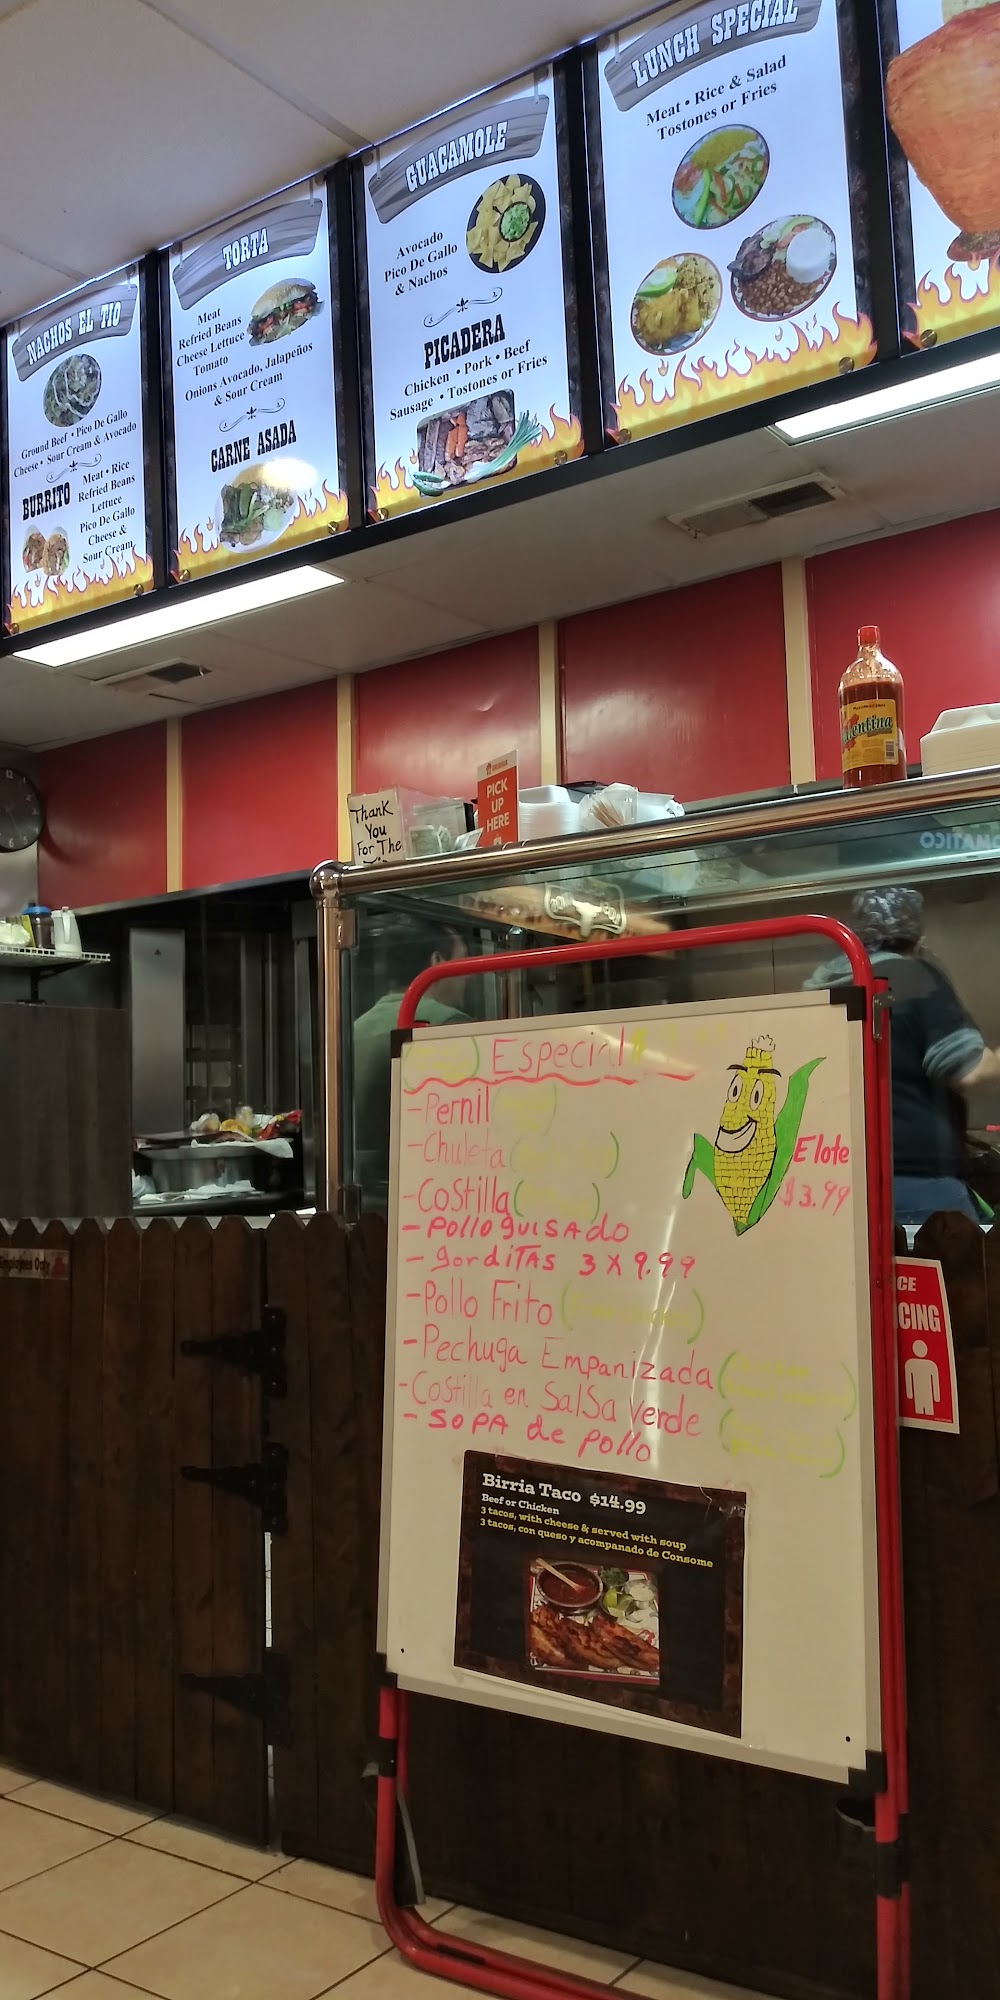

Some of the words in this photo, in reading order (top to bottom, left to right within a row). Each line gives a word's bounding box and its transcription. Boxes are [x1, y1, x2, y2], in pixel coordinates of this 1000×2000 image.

[631, 23, 701, 89] LUNCH
[710, 0, 799, 46] SPECIAL
[646, 102, 681, 127] Meat
[694, 83, 725, 105] Rice
[729, 75, 742, 90] &
[746, 55, 787, 83] Salad
[657, 106, 718, 141] Tostones
[721, 99, 737, 114] or
[741, 82, 778, 107] Fries
[405, 121, 509, 192] GUACAMOLE
[222, 227, 269, 271] TORTA
[384, 265, 408, 283] Pico
[409, 257, 425, 273] De
[427, 242, 458, 264] Gallo
[396, 231, 444, 260] Avocado
[395, 283, 405, 296] &
[408, 266, 449, 291] Nachos
[26, 317, 73, 366] NACHOS
[78, 308, 94, 335] EL
[100, 301, 121, 329] TIO
[178, 326, 212, 350] Refried
[215, 316, 242, 336] Beans
[197, 308, 221, 325] Meat
[176, 347, 208, 368] Cheese
[210, 330, 245, 352] Lettuce
[423, 313, 506, 370] PICADERA
[185, 380, 218, 402] Onions
[219, 362, 263, 388] Avocado,
[265, 342, 313, 370] Jalapeños
[193, 354, 229, 377] Tomato
[404, 372, 450, 397] Chicken
[464, 355, 493, 375] Pork
[503, 339, 531, 360] Beef
[213, 394, 223, 407] &
[225, 386, 248, 403] Sour
[250, 371, 283, 392] Cream
[390, 397, 434, 421] Sausage
[447, 373, 498, 400] Tostones
[501, 367, 514, 380] or
[517, 355, 548, 375] Fries
[13, 461, 39, 478] Cheese
[47, 450, 64, 465] Sour
[66, 441, 92, 457] Cream
[93, 435, 101, 445] &
[103, 421, 137, 442] Avocado
[21, 440, 49, 460] Ground
[51, 432, 68, 449] Beef
[76, 424, 92, 438] Pico
[94, 419, 105, 430] De
[106, 410, 128, 425] Gallo
[211, 436, 250, 473] CARNE
[257, 419, 297, 456] ASADA
[78, 483, 108, 502] Refried
[110, 474, 136, 490] Beans
[82, 470, 104, 485] Meat
[111, 460, 130, 474] Rice
[22, 481, 70, 521] BURRITO
[80, 519, 97, 533] Pico
[99, 514, 110, 525] De
[112, 506, 136, 522] Gallo
[91, 495, 123, 513] Lettuce
[82, 550, 103, 563] Sour
[104, 539, 133, 557] Cream
[88, 530, 117, 546] Cheese
[118, 524, 127, 535] &
[486, 778, 509, 799] PICK
[491, 797, 504, 813] UP
[349, 800, 394, 824] Thank
[486, 812, 510, 833] HERE
[357, 841, 375, 856] For
[377, 838, 402, 856] The
[365, 823, 387, 840] You
[492, 1025, 625, 1078] Especial
[425, 1085, 490, 1125] Pernil
[792, 1133, 850, 1165] Elote
[778, 1176, 851, 1217] $3.99
[578, 1253, 597, 1276] 3
[633, 1251, 696, 1281] 9.99
[424, 1277, 478, 1319] Pollo
[492, 1279, 553, 1326] Frito
[423, 1323, 528, 1373] Pechuga
[541, 1336, 713, 1390] Empanizada
[503, 1387, 529, 1409] en
[526, 1413, 565, 1444] de
[481, 1493, 505, 1506] Beef
[505, 1499, 517, 1507] or
[518, 1499, 560, 1515] Chicken
[482, 1472, 536, 1496] Birria
[538, 1482, 582, 1503] Taco
[589, 1492, 647, 1516] $14.99
[479, 1518, 486, 1527] 3
[487, 1519, 517, 1533] tacos,
[518, 1525, 536, 1536] con
[537, 1528, 568, 1544] queso
[569, 1534, 577, 1544] y
[577, 1535, 645, 1556] acompanado
[646, 1548, 660, 1559] de
[661, 1550, 714, 1568] Consome
[480, 1506, 487, 1515] 3
[487, 1507, 517, 1520] tacos,
[518, 1511, 543, 1525] with
[543, 1517, 580, 1532] cheese
[581, 1523, 590, 1534] &
[591, 1526, 630, 1540] served
[630, 1531, 658, 1545] with
[659, 1537, 687, 1552] soup
